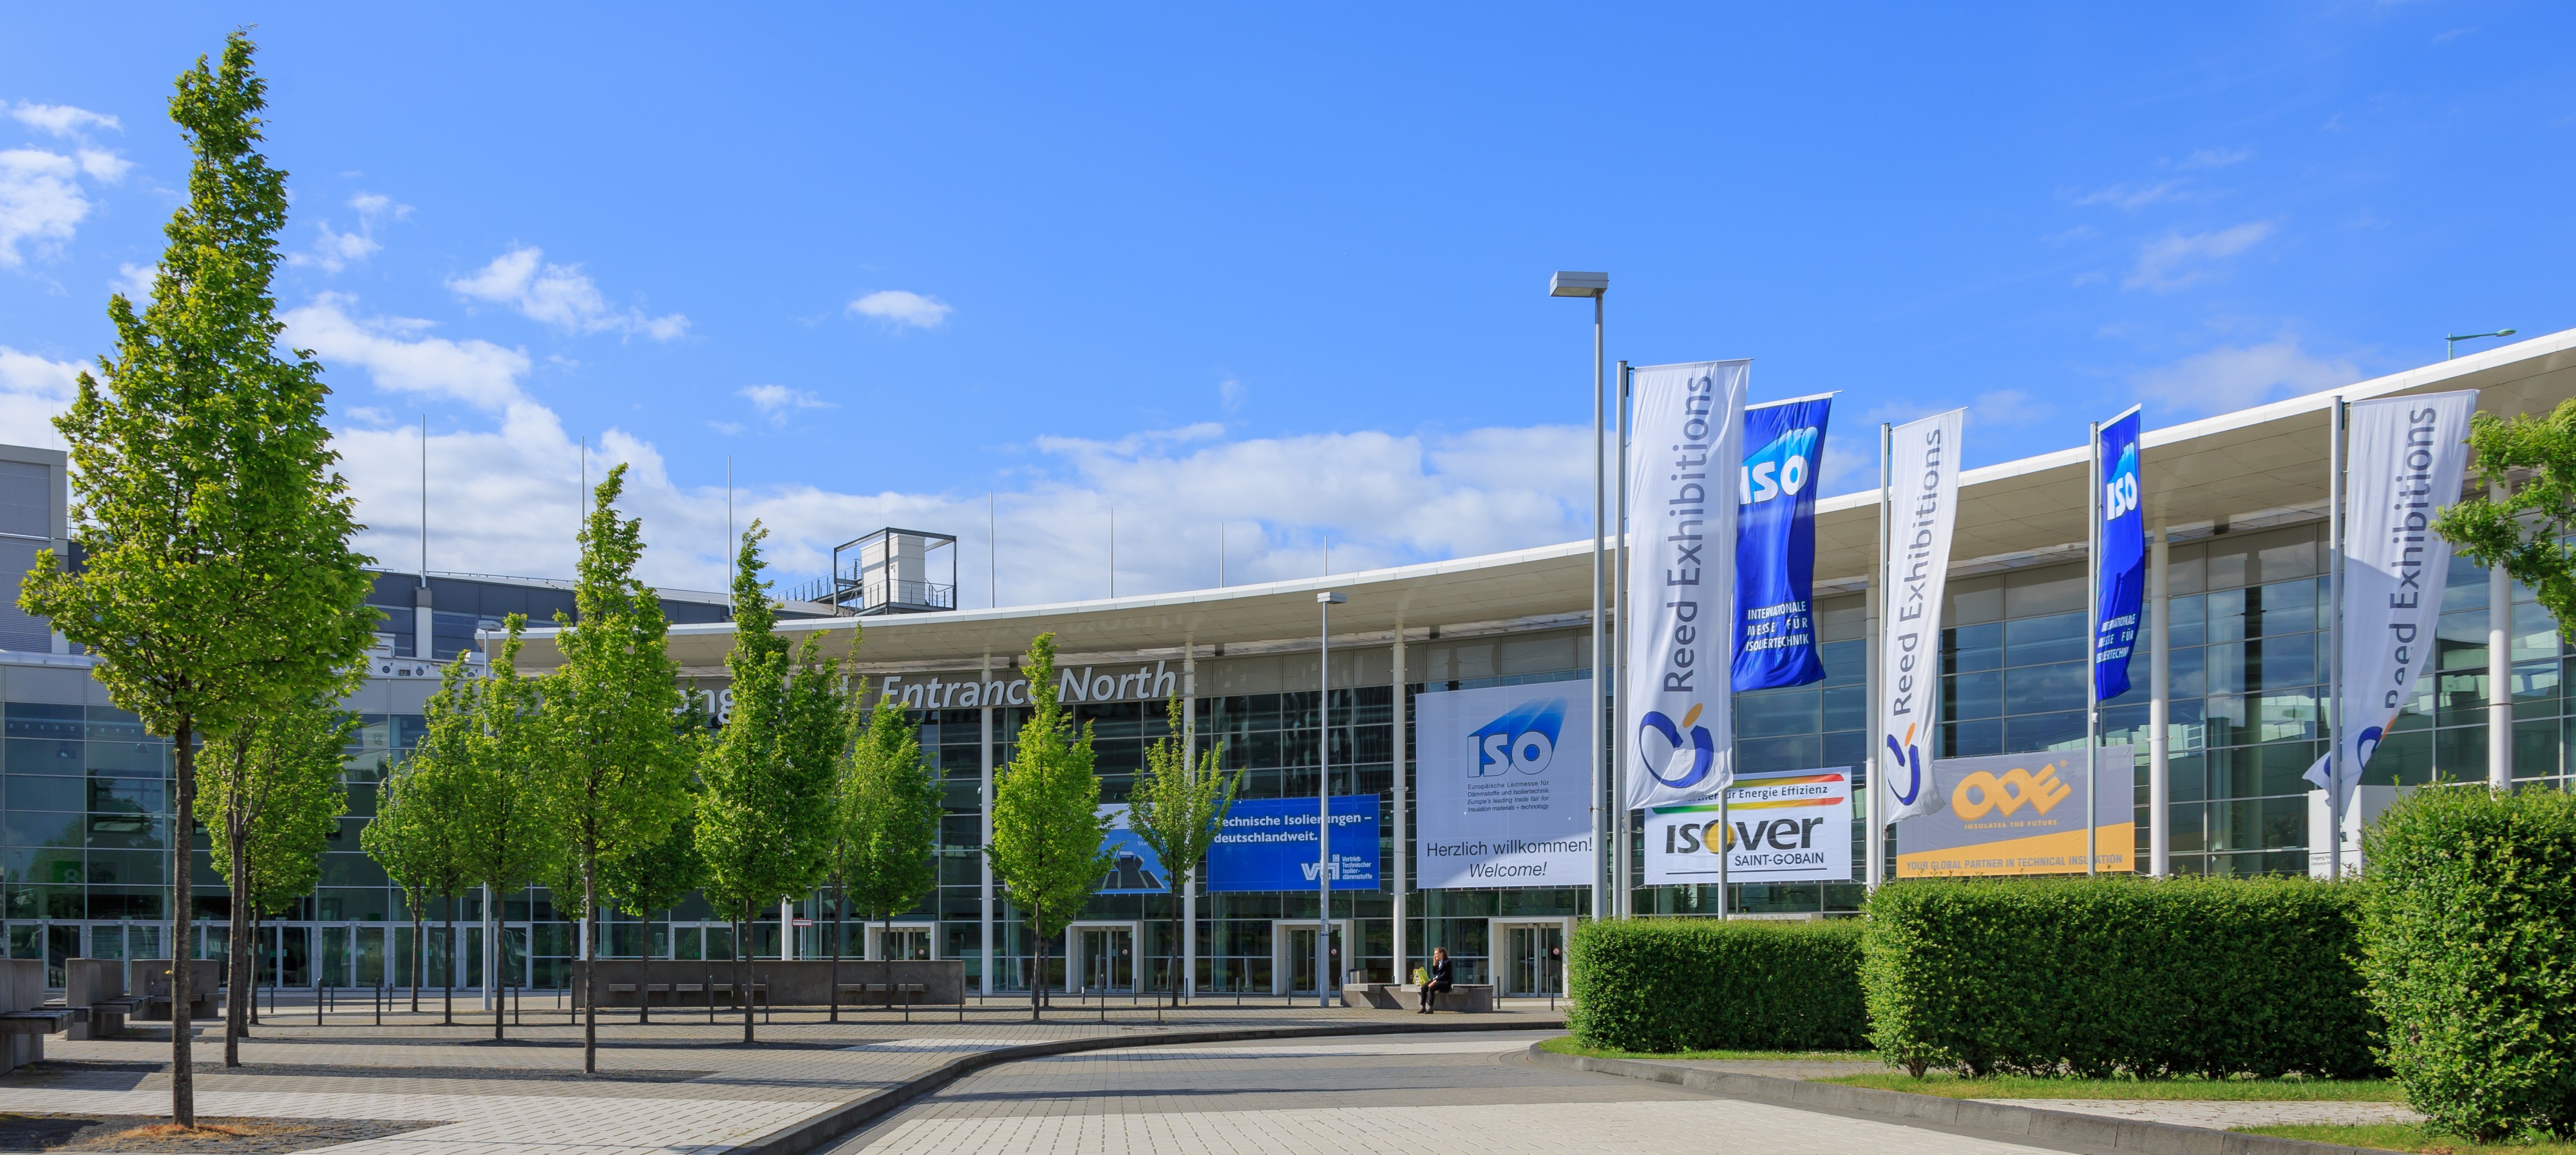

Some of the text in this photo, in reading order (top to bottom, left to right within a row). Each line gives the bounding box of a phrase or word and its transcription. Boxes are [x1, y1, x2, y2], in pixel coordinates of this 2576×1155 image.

[1739, 455, 1808, 505] ISO
[2107, 471, 2137, 521] ISO
[2389, 406, 2436, 609] Exhibitions
[1663, 375, 1713, 692] Reed Exhibitions
[1893, 428, 1941, 717] Reed Exhibitions
[1747, 615, 1808, 636] MESSE FÜR
[2121, 628, 2134, 642] FÜR
[881, 676, 1034, 709] Entranc
[1057, 661, 1176, 703] North
[1468, 730, 1553, 778] ISO
[1727, 789, 1736, 799] ür
[1739, 785, 1778, 800] Energie
[1781, 781, 1828, 796] Effizienz
[1951, 763, 2072, 820] ODE
[1965, 822, 2007, 830] INSULATES
[1214, 831, 1318, 843] deutschlandweit.
[1427, 836, 1593, 857] Herzlich willkommen!
[1470, 861, 1548, 878] Welcome!
[1734, 852, 1824, 867] SAINT-GOBAIN
[1906, 862, 1928, 870] YOUR
[1931, 860, 1962, 869] GLOBAL
[1965, 859, 2003, 868] PARTNER
[2018, 857, 2066, 866] TECHNICAL
[2069, 854, 2123, 865] INSUATION
